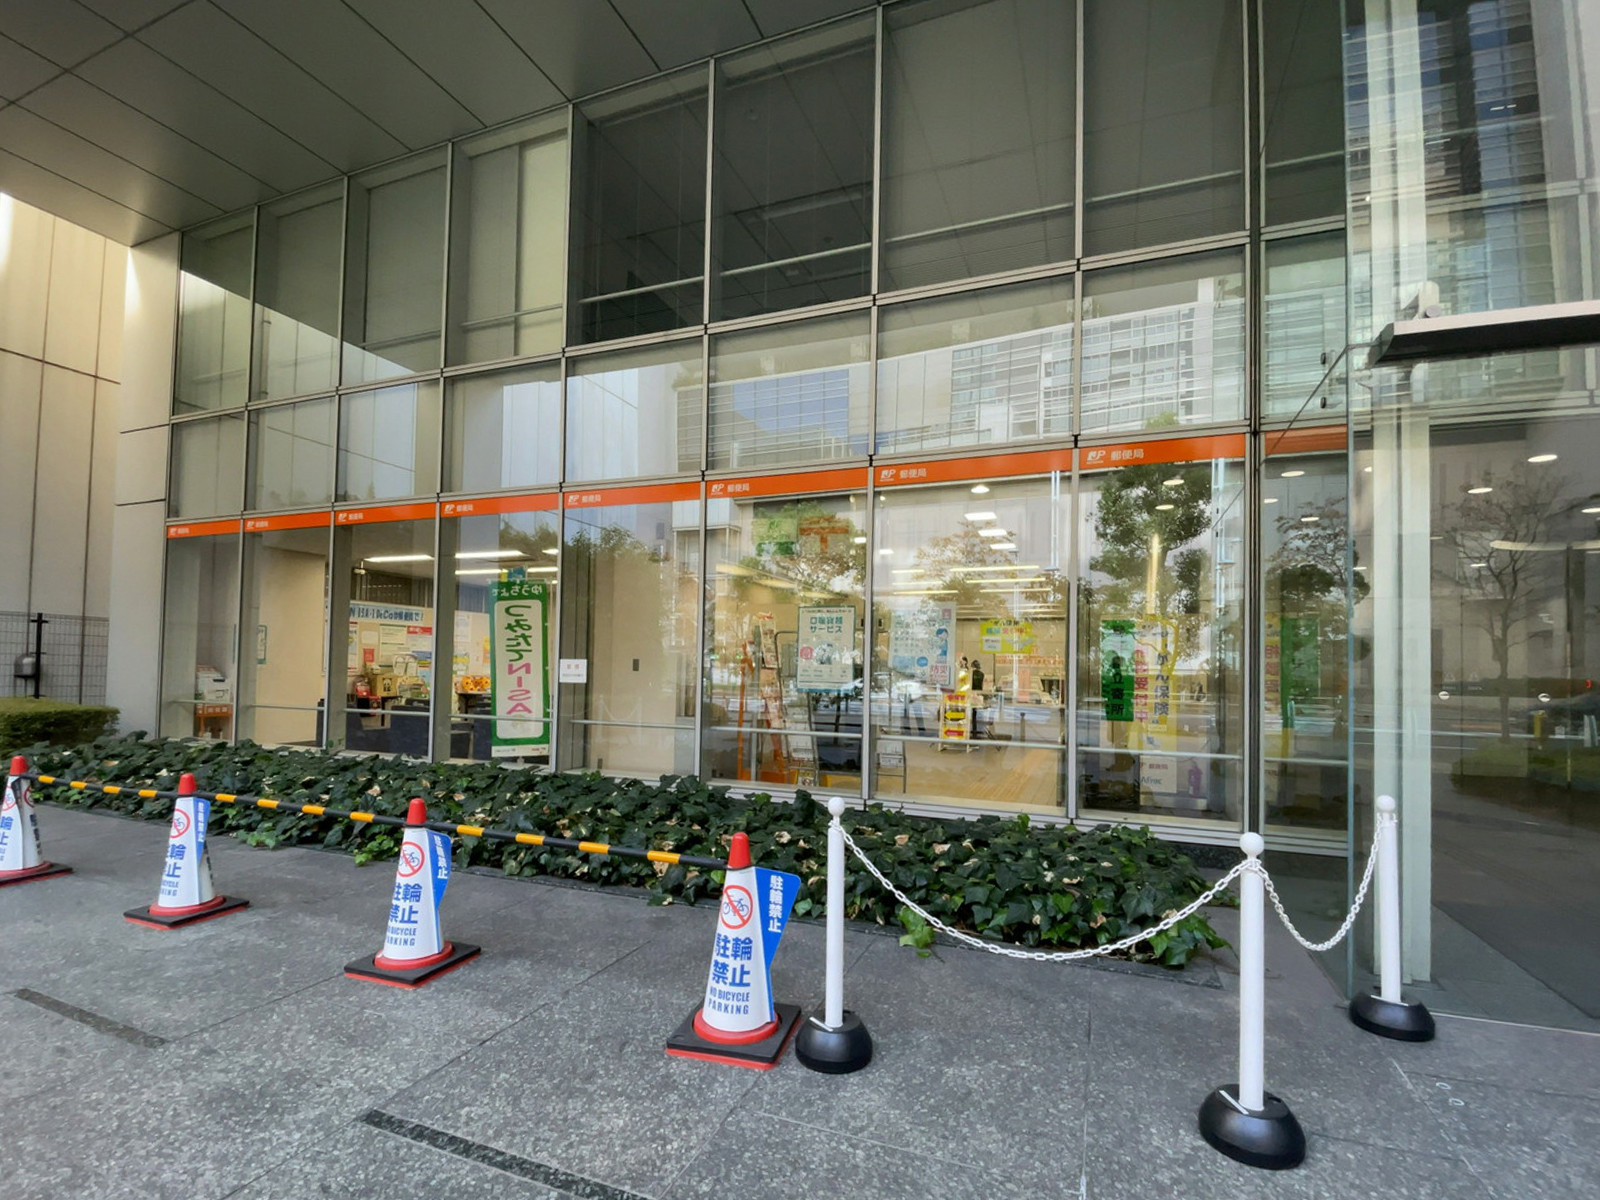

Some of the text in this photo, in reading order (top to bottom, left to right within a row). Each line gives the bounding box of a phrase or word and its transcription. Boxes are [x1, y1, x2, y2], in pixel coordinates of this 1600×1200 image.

[1110, 449, 1144, 461] 郵便局
[899, 467, 927, 479] 郵便局
[727, 483, 750, 493] 郵便局
[809, 626, 843, 634] サービス
[1154, 652, 1170, 716] がん保険
[168, 843, 187, 860] 輪
[433, 834, 449, 880] 駐輪禁止
[165, 861, 182, 878] 止
[768, 874, 784, 934] 駐輪禁止
[715, 933, 753, 962] 駐輪
[711, 960, 752, 988] 禁止
[709, 986, 750, 1003] NO BICYCLE
[707, 999, 749, 1015] PARKING
